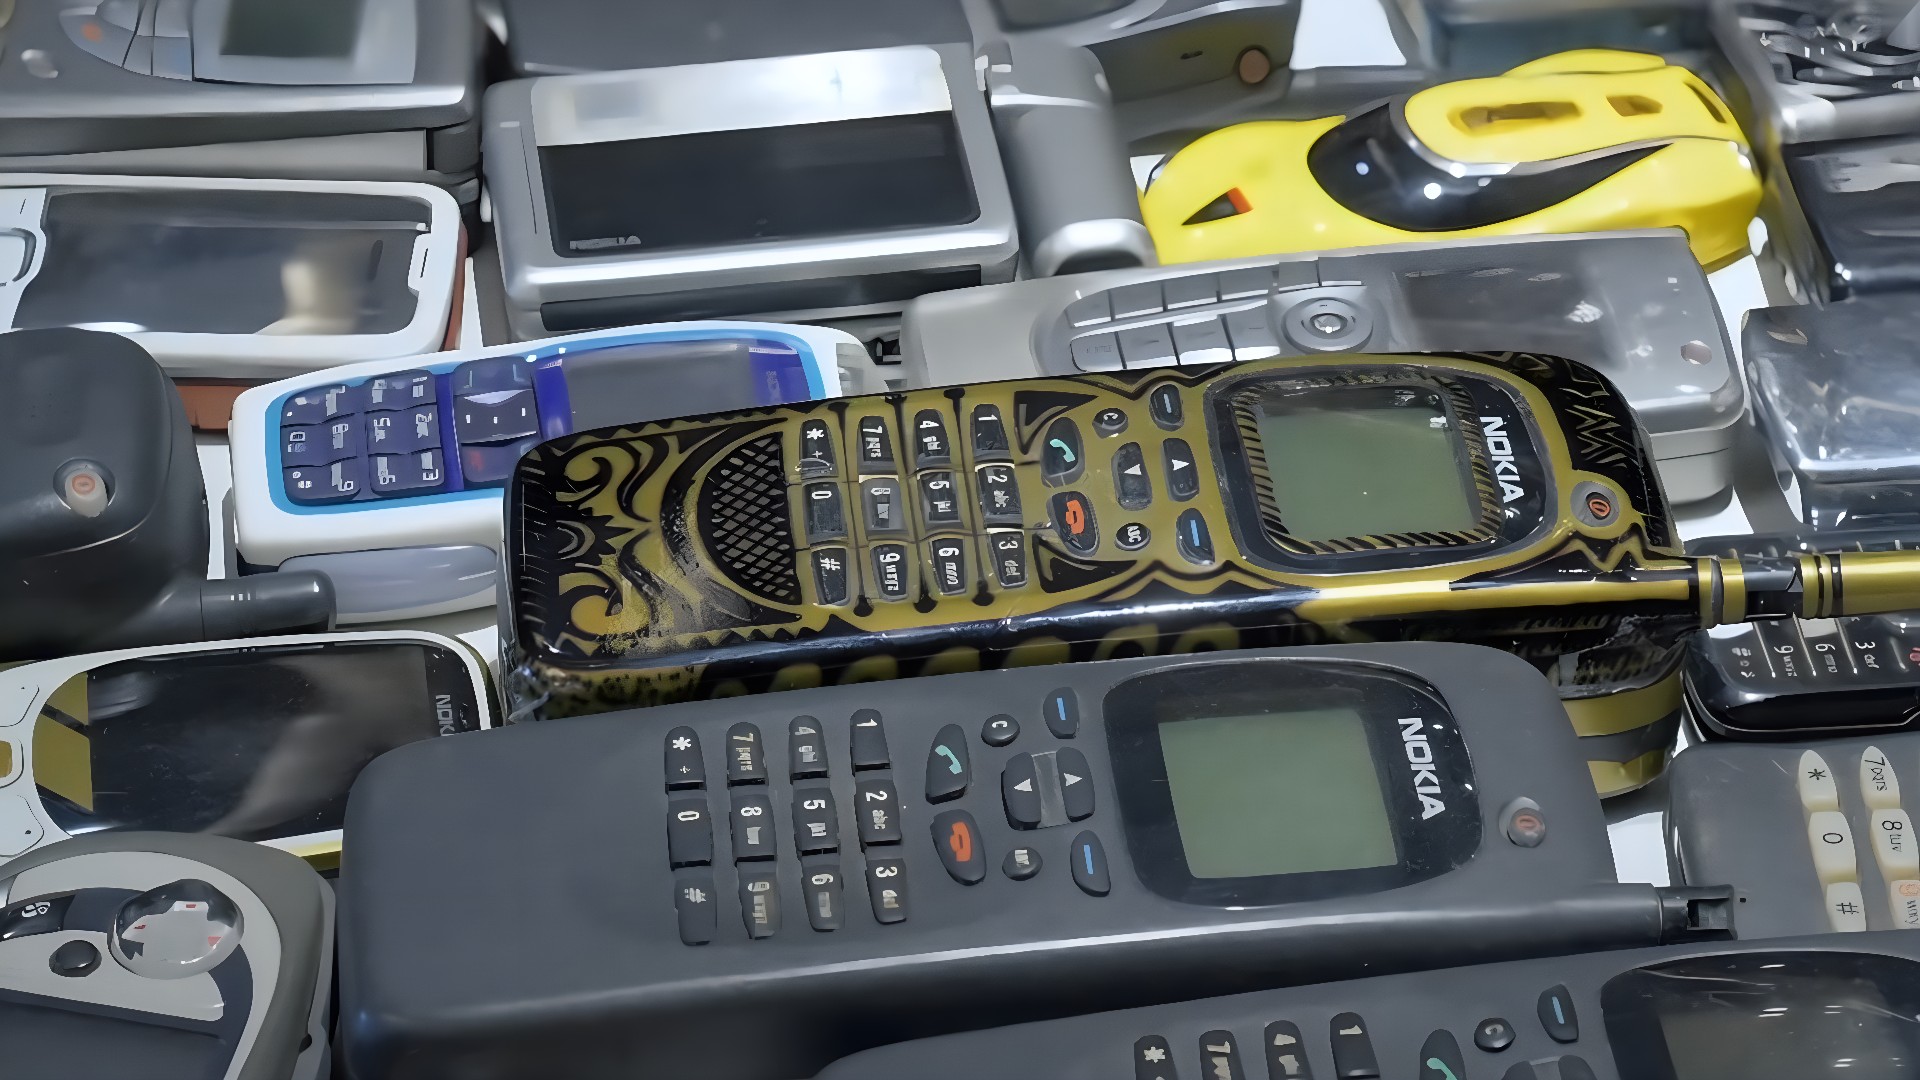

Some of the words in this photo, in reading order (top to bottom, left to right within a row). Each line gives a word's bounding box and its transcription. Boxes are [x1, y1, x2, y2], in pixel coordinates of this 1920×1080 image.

[978, 414, 998, 422] 1
[862, 425, 883, 435] 7
[919, 420, 939, 429] 4
[1479, 416, 1526, 504] NOKIA
[987, 472, 1008, 484] 2
[998, 538, 1019, 550] 3
[879, 552, 901, 563] 9
[938, 546, 960, 558] 6
[1773, 645, 1794, 654] 9
[1815, 643, 1836, 652] 6
[1855, 641, 1876, 649] 3
[435, 694, 456, 737] NOKI
[856, 718, 878, 728] 1
[733, 732, 754, 742] 7
[1864, 757, 1886, 766] 7
[1398, 717, 1446, 821] NOKIA
[865, 790, 888, 802] 2
[803, 798, 826, 810] 5
[740, 806, 762, 817] 8
[1881, 820, 1903, 831] 8
[1822, 832, 1843, 845] 0
[875, 866, 898, 878] 3
[811, 873, 834, 885] 6
